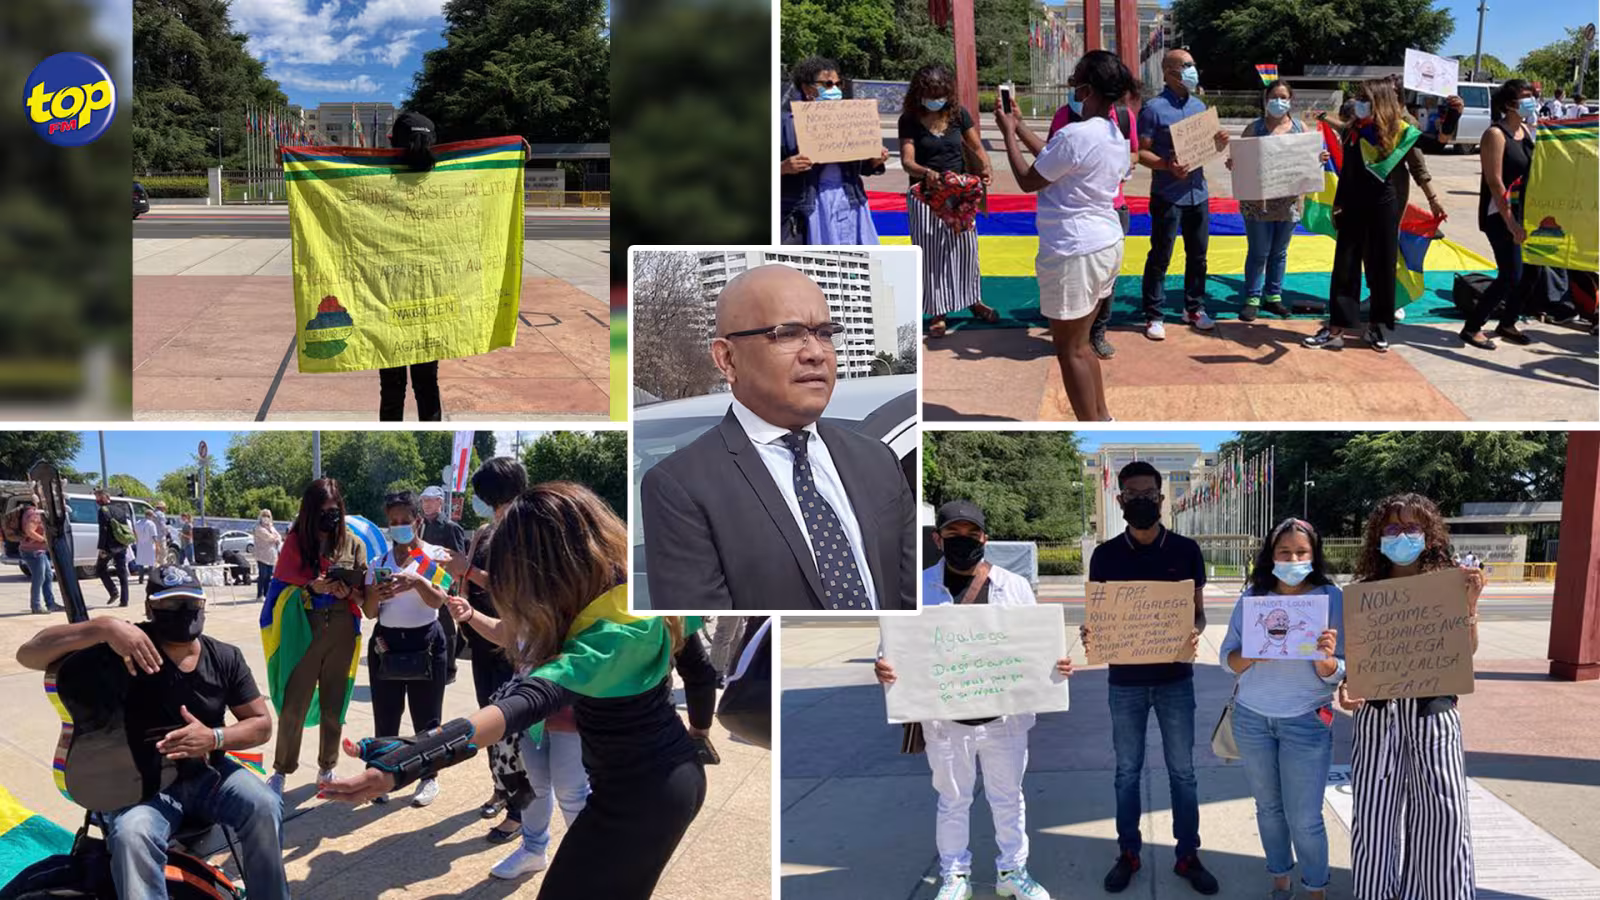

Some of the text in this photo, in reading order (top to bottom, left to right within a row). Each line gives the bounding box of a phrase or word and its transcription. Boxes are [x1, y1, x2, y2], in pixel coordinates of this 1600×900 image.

[406, 184, 449, 201] BASE
[404, 204, 477, 221] AGALEGA
[466, 258, 482, 272] AU
[392, 302, 455, 320] MAURICIEN
[1091, 585, 1148, 608] # FREE
[1133, 598, 1188, 613] AGALEGA
[1361, 588, 1410, 612] NOUS
[1367, 605, 1444, 627] SOMMES
[1357, 624, 1437, 645] SOLIDAIRES
[1370, 636, 1446, 658] AGALEGA
[1374, 676, 1440, 698] TEAM
